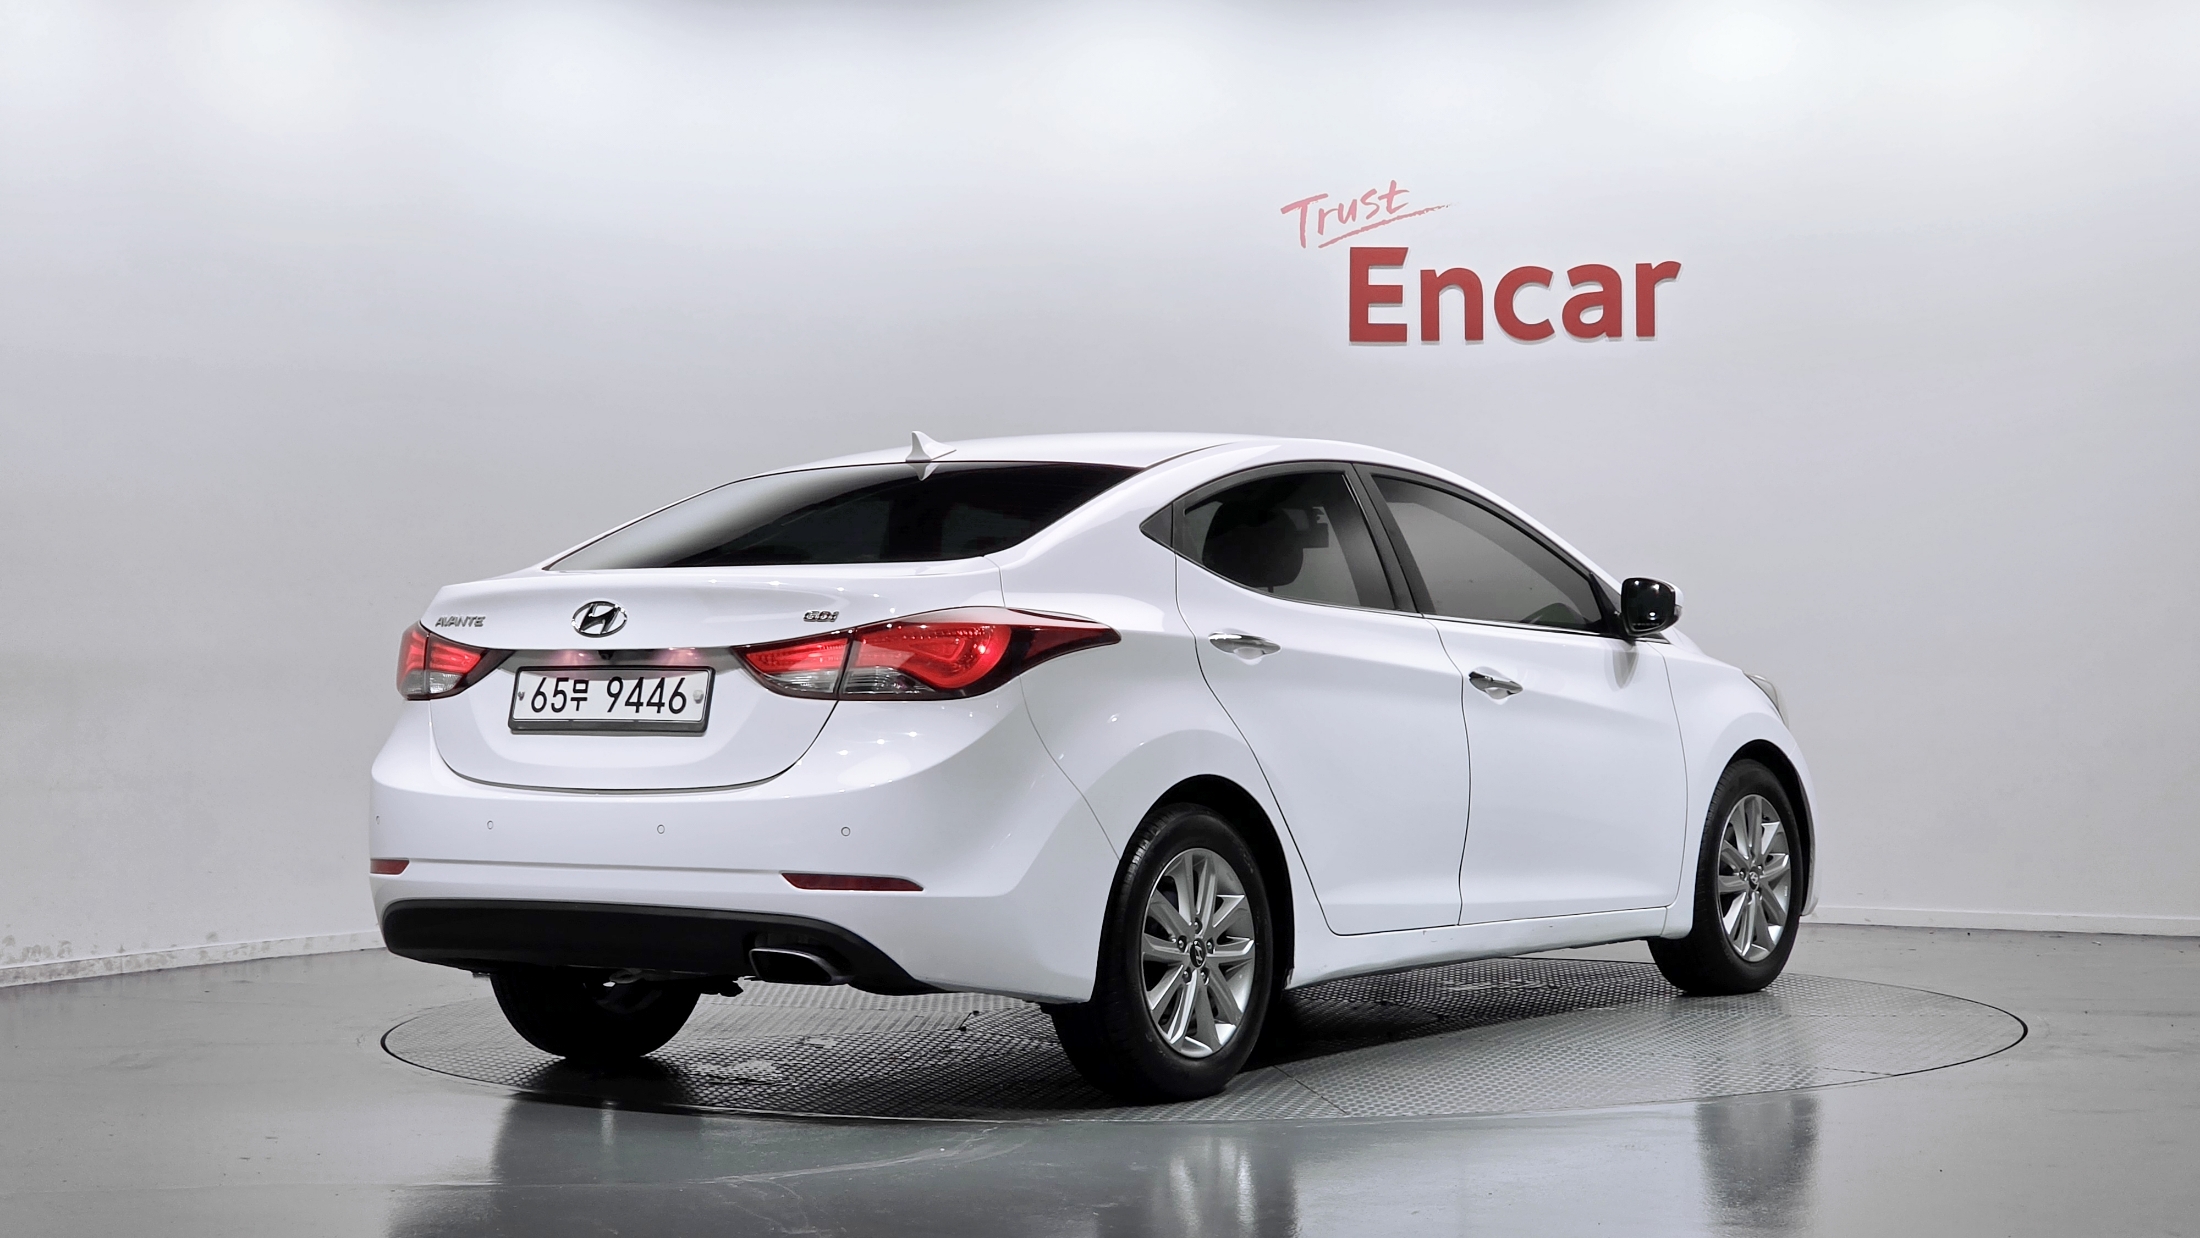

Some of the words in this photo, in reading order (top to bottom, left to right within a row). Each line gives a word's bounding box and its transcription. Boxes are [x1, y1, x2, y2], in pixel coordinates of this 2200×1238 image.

[1281, 180, 1409, 248] Trust
[1349, 247, 1681, 343] Encar
[434, 615, 486, 627] AVANTE
[531, 677, 589, 713] 65무
[606, 676, 687, 714] 9446
